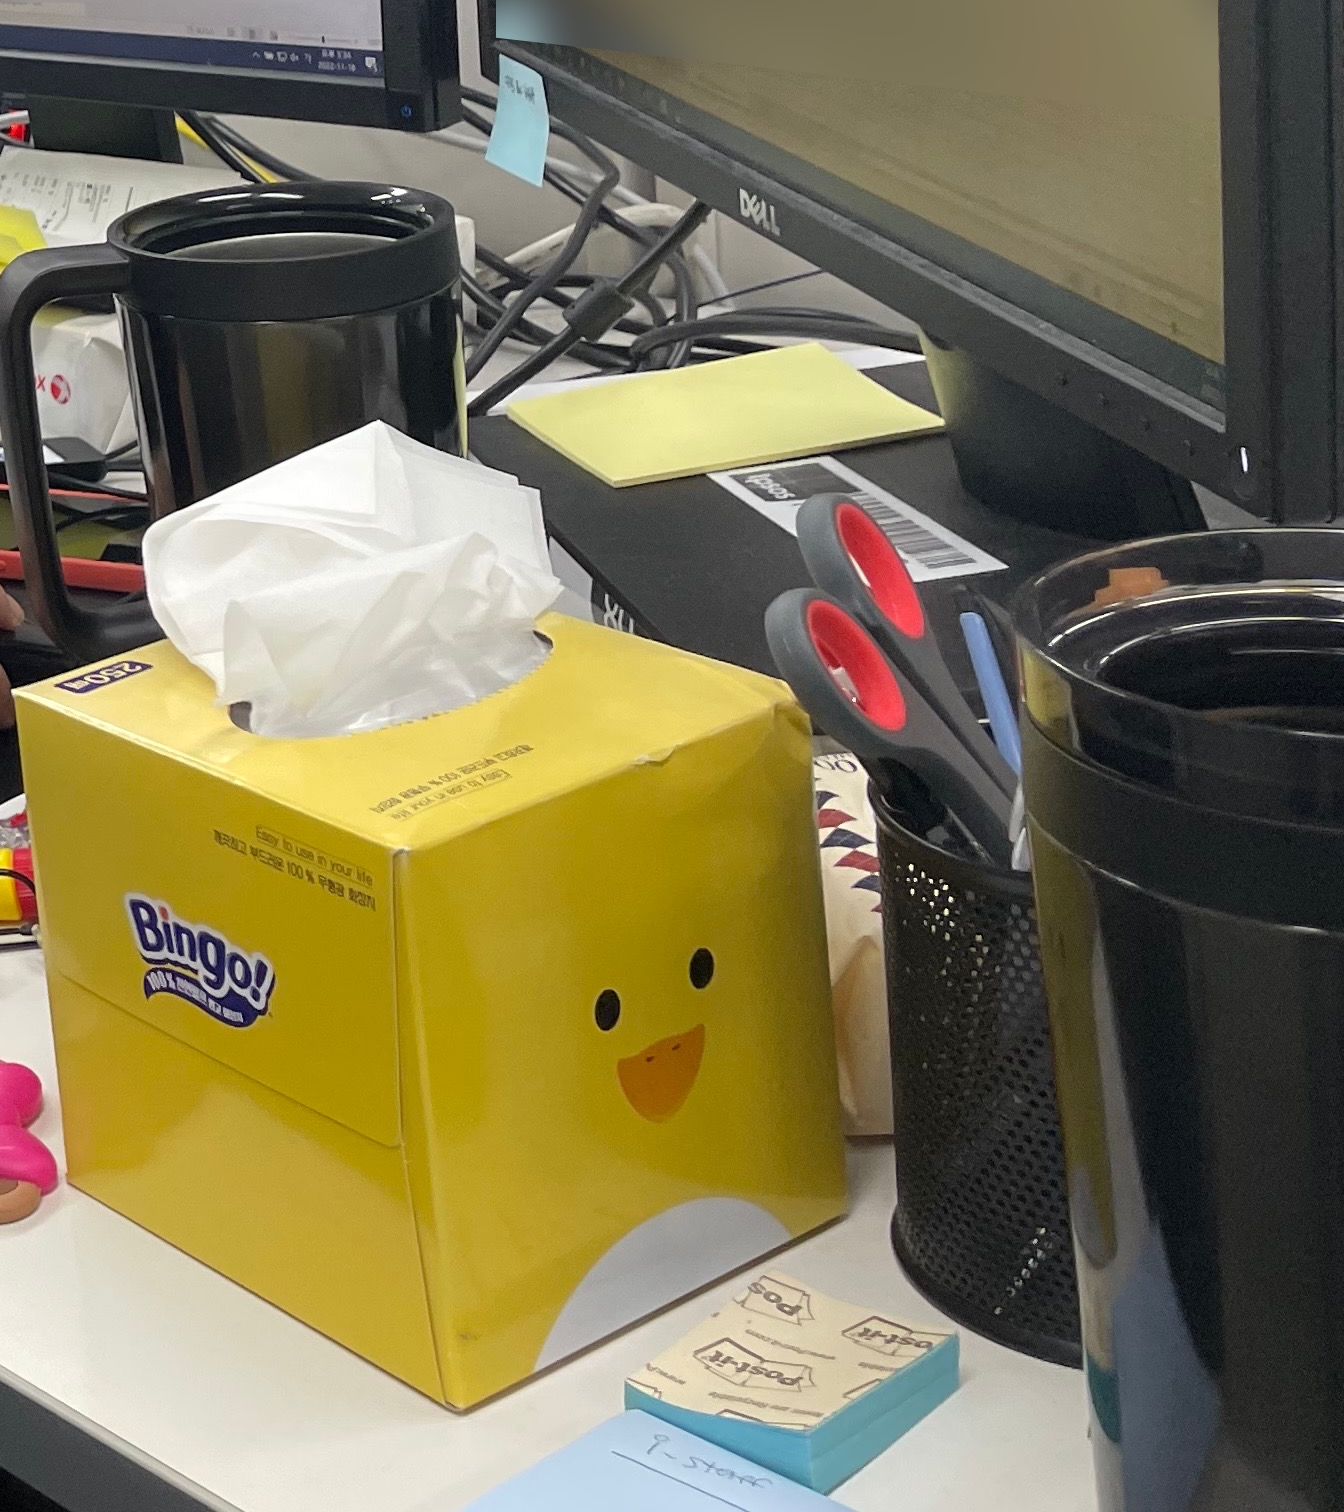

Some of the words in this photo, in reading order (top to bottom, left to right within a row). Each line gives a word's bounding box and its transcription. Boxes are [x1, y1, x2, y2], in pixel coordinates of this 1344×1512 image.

[739, 187, 781, 237] DELL
[256, 825, 279, 847] Easy
[283, 839, 293, 852] to
[296, 847, 314, 862] use
[317, 855, 327, 869] in
[330, 861, 353, 877] your
[356, 866, 373, 886] life
[129, 898, 268, 1002] Bingo!
[707, 1349, 804, 1387] Post-it
